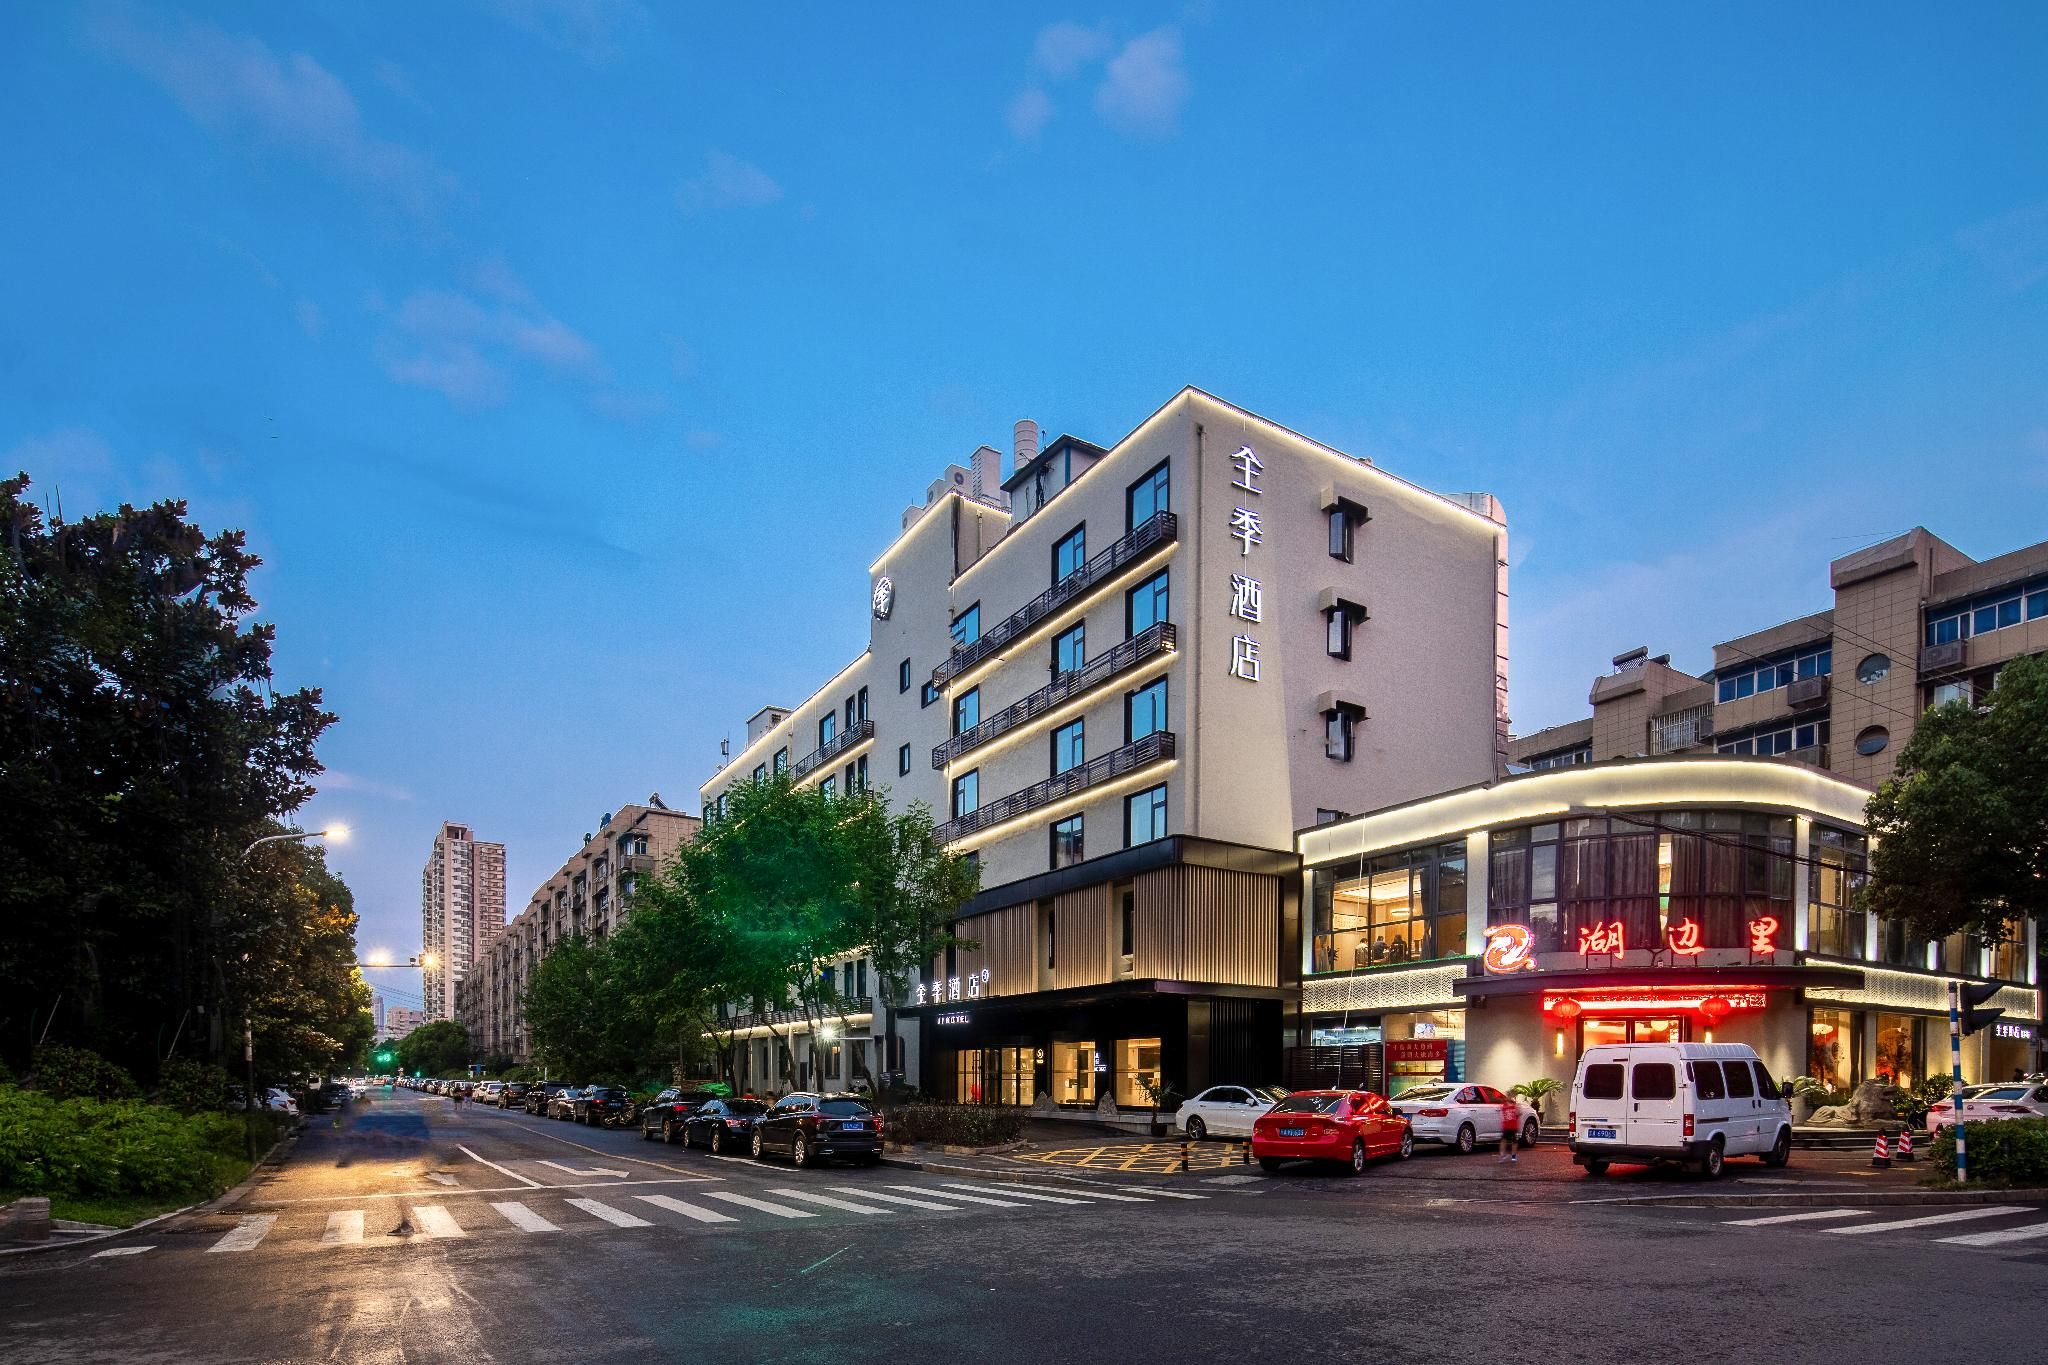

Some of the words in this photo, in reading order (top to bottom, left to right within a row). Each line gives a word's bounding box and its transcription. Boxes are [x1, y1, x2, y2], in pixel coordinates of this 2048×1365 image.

[1229, 445, 1265, 682] 全季酒店
[1578, 917, 1779, 960] 湖边里
[916, 973, 980, 1004] 全季酒店
